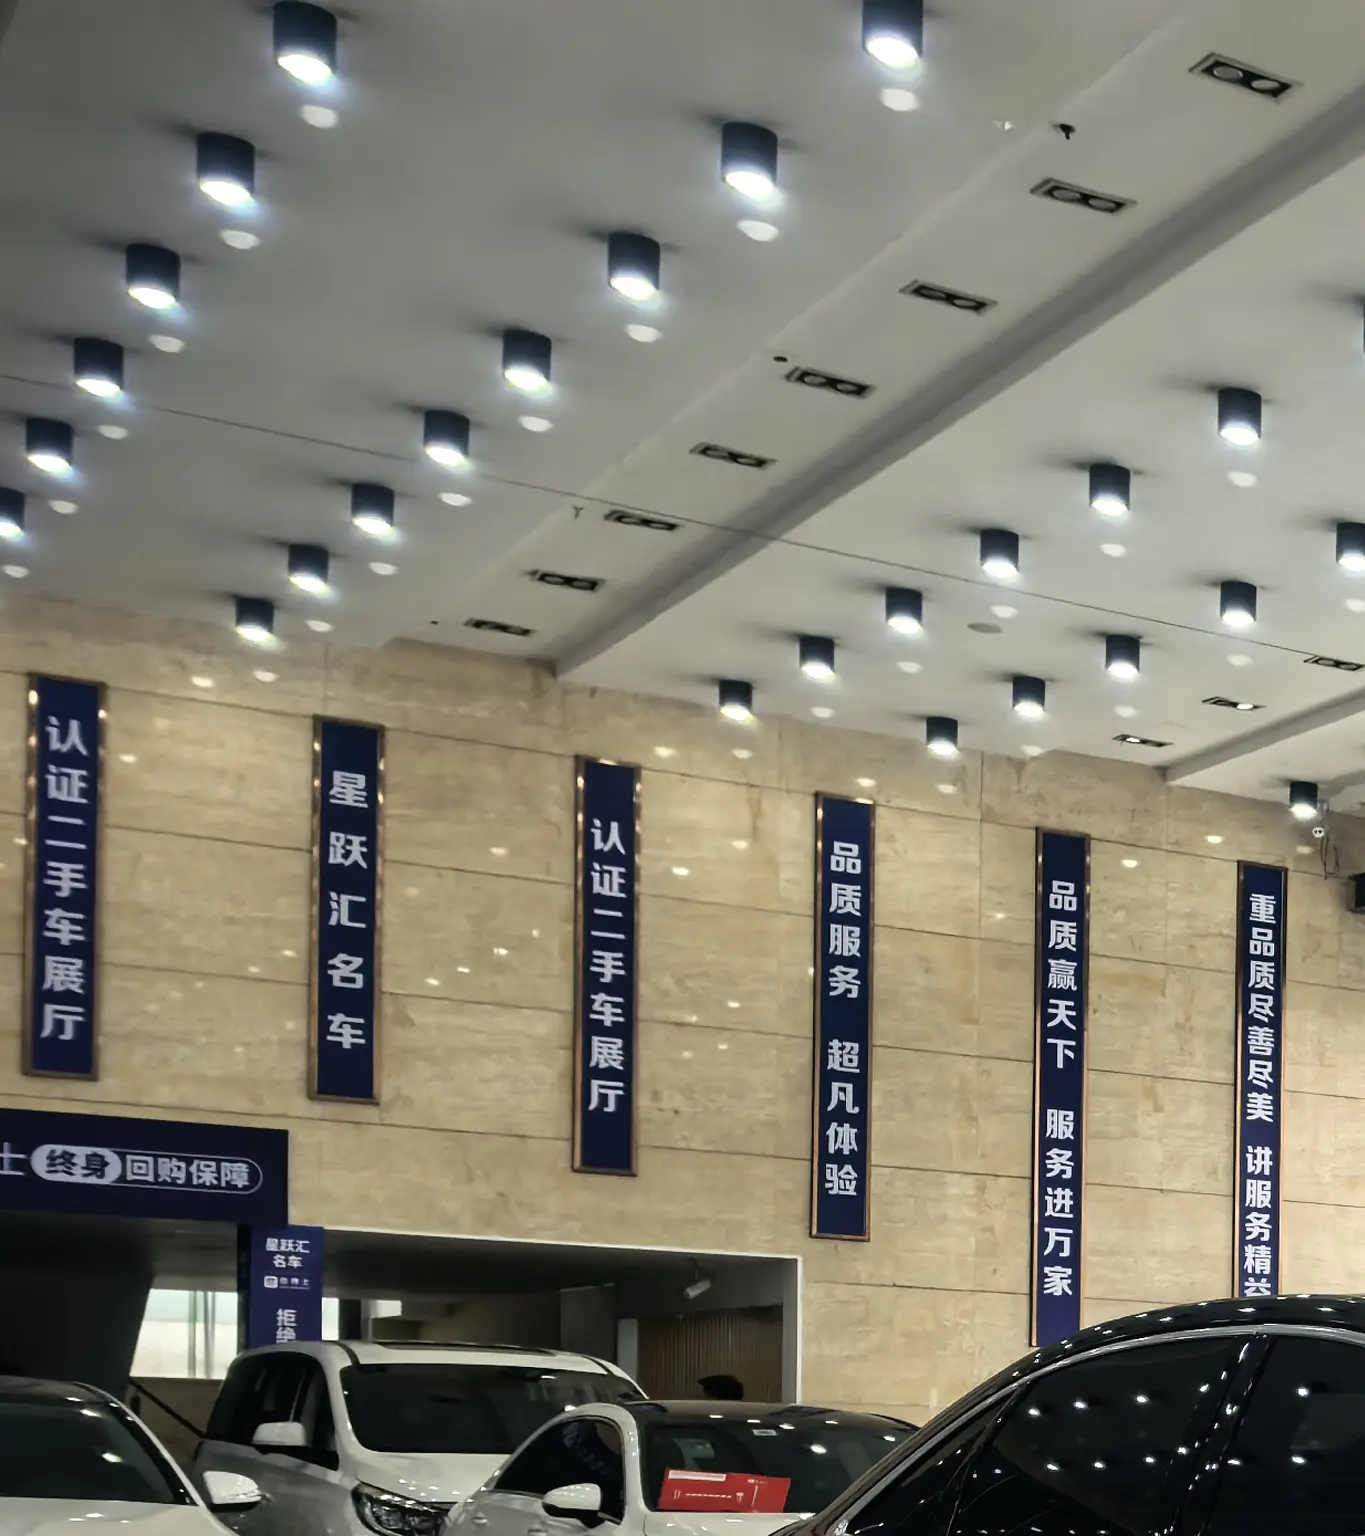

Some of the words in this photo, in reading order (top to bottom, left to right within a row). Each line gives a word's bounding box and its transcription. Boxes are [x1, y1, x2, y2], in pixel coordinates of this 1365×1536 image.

[41, 716, 89, 1041] 认证二手车展厅
[326, 771, 369, 1050] 星跃汇名车
[588, 819, 628, 1113] 认证二手车展厅
[828, 842, 862, 999] 品质服务
[1047, 880, 1078, 1070] 品质赢天下
[1247, 894, 1277, 1124] 重品质尽善尽美
[825, 1039, 861, 1197] 超凡体验
[1043, 1108, 1075, 1297] 服务进万家
[273, 1254, 302, 1268] 名车
